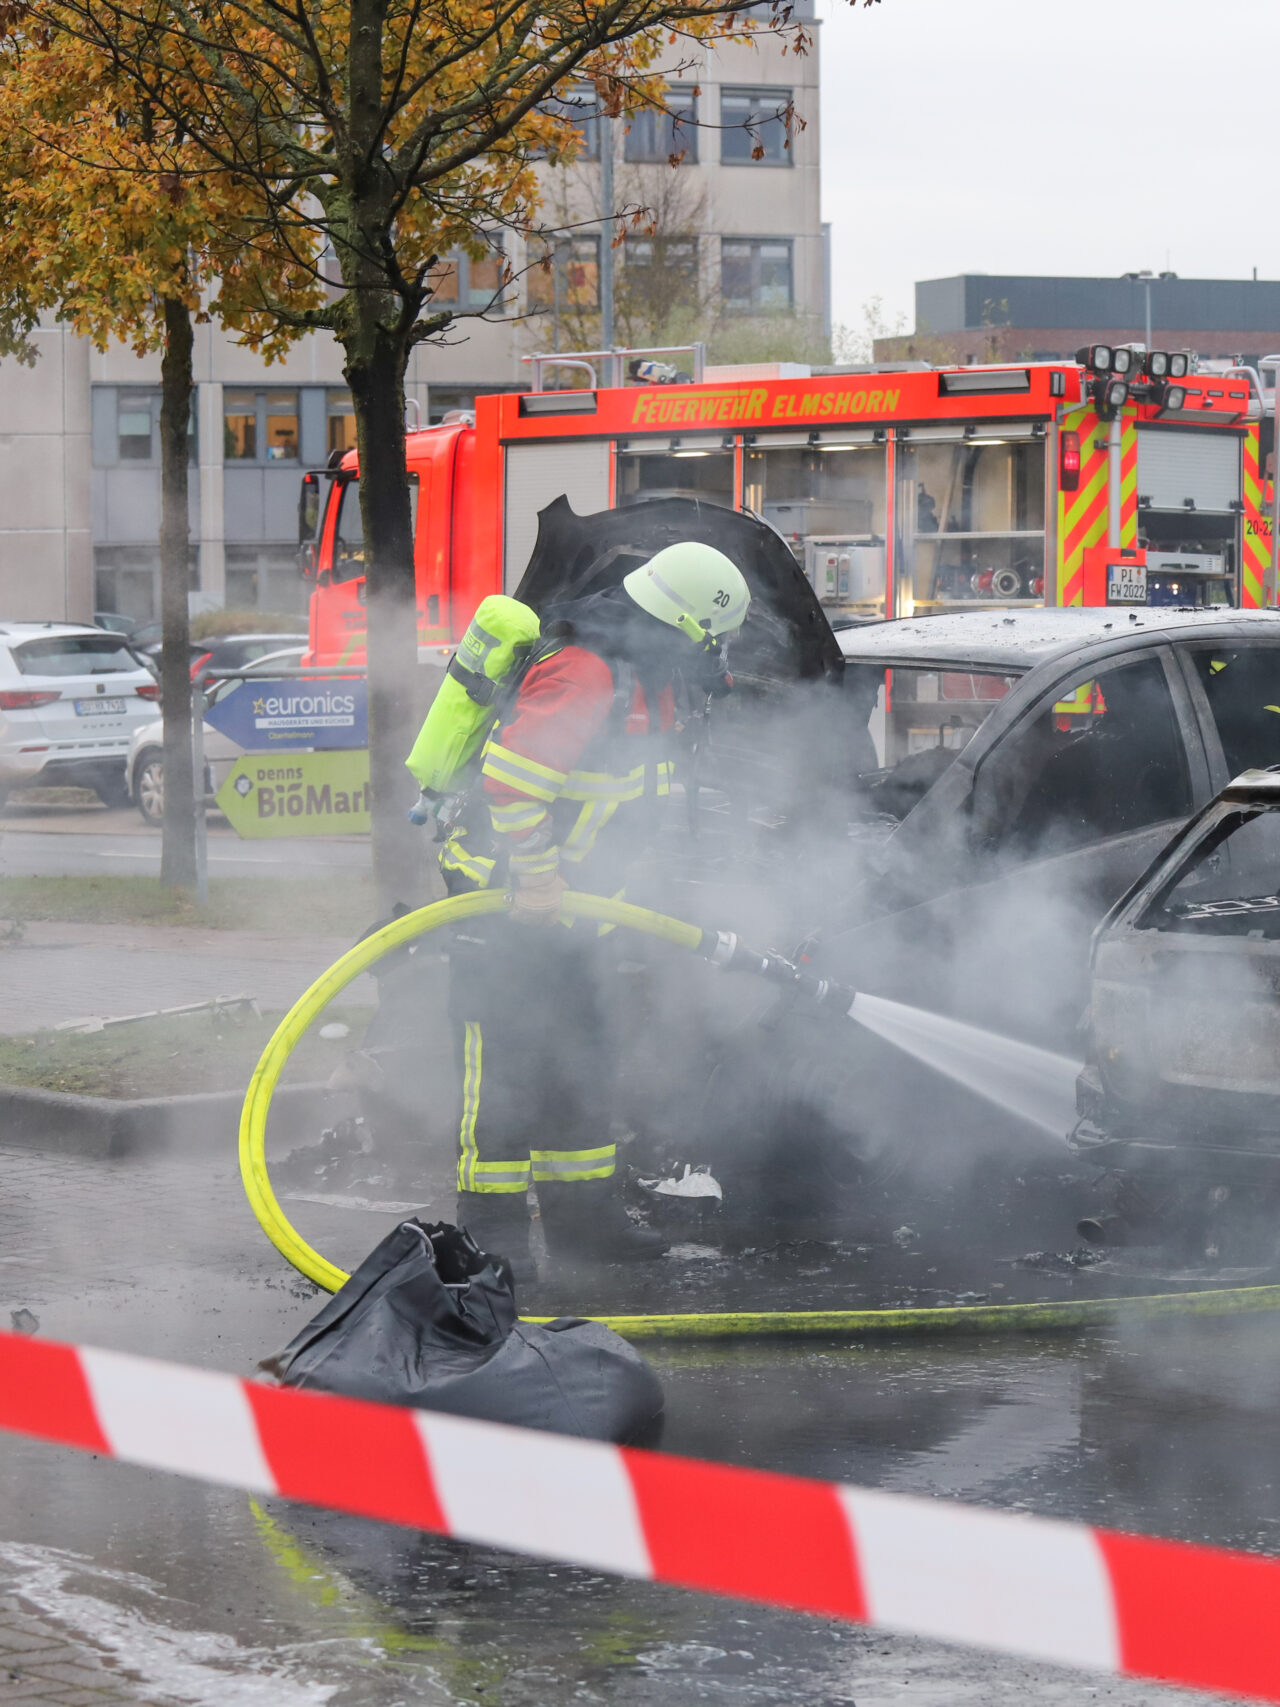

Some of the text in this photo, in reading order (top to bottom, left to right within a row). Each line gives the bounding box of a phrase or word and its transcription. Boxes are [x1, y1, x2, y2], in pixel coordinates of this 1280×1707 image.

[632, 388, 900, 424] FEUERWEHR ELMSHORN
[1121, 568, 1133, 583] PI
[712, 590, 730, 608] 20
[1111, 583, 1145, 599] FW 2022
[266, 691, 355, 716] euronics
